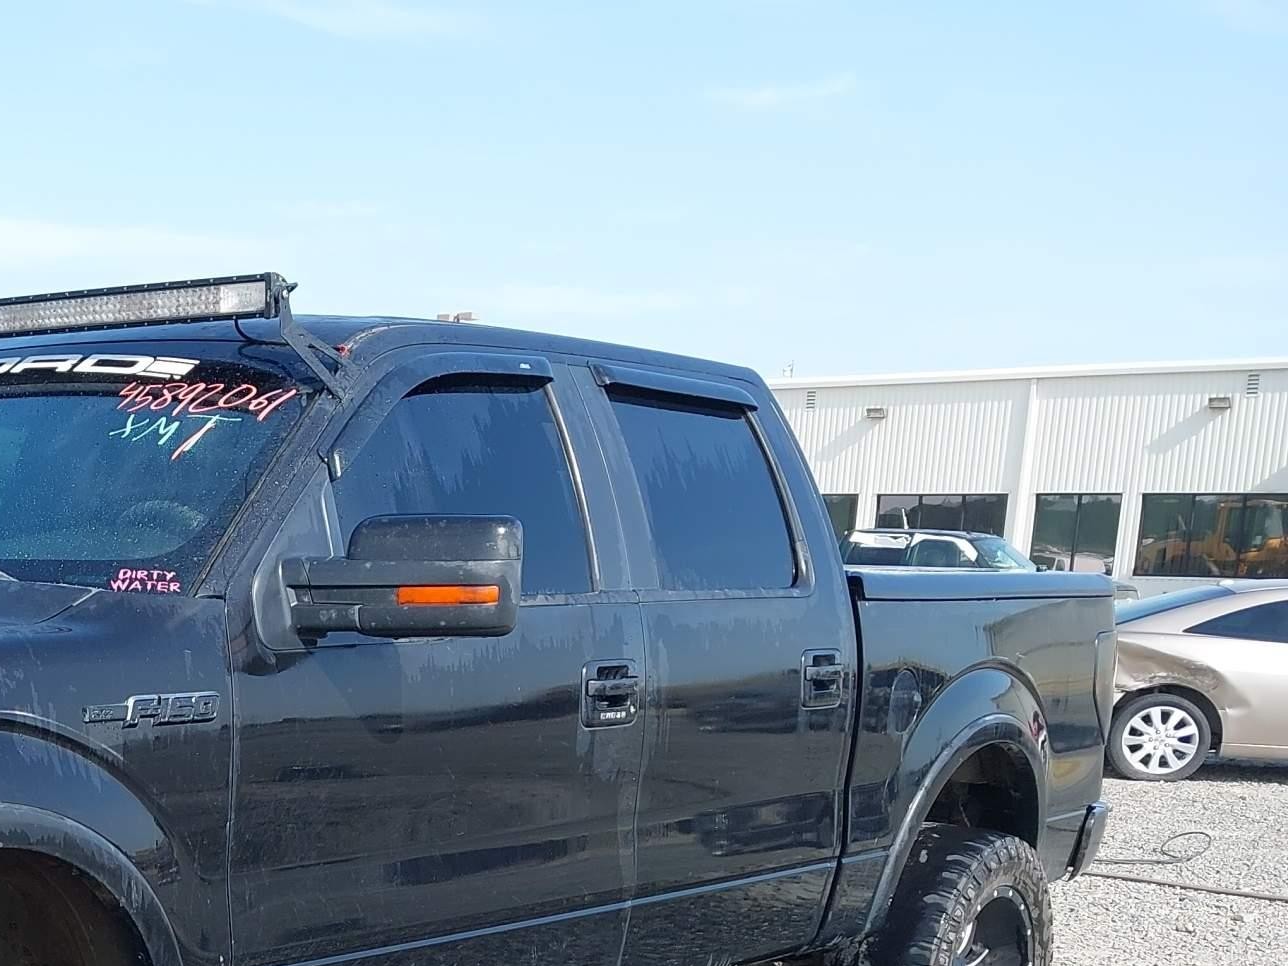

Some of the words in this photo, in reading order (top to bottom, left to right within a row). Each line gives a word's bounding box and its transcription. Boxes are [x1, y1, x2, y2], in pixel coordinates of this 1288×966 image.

[116, 381, 297, 422] 45892061
[118, 568, 177, 581] DIRTY
[110, 579, 181, 593] WATER
